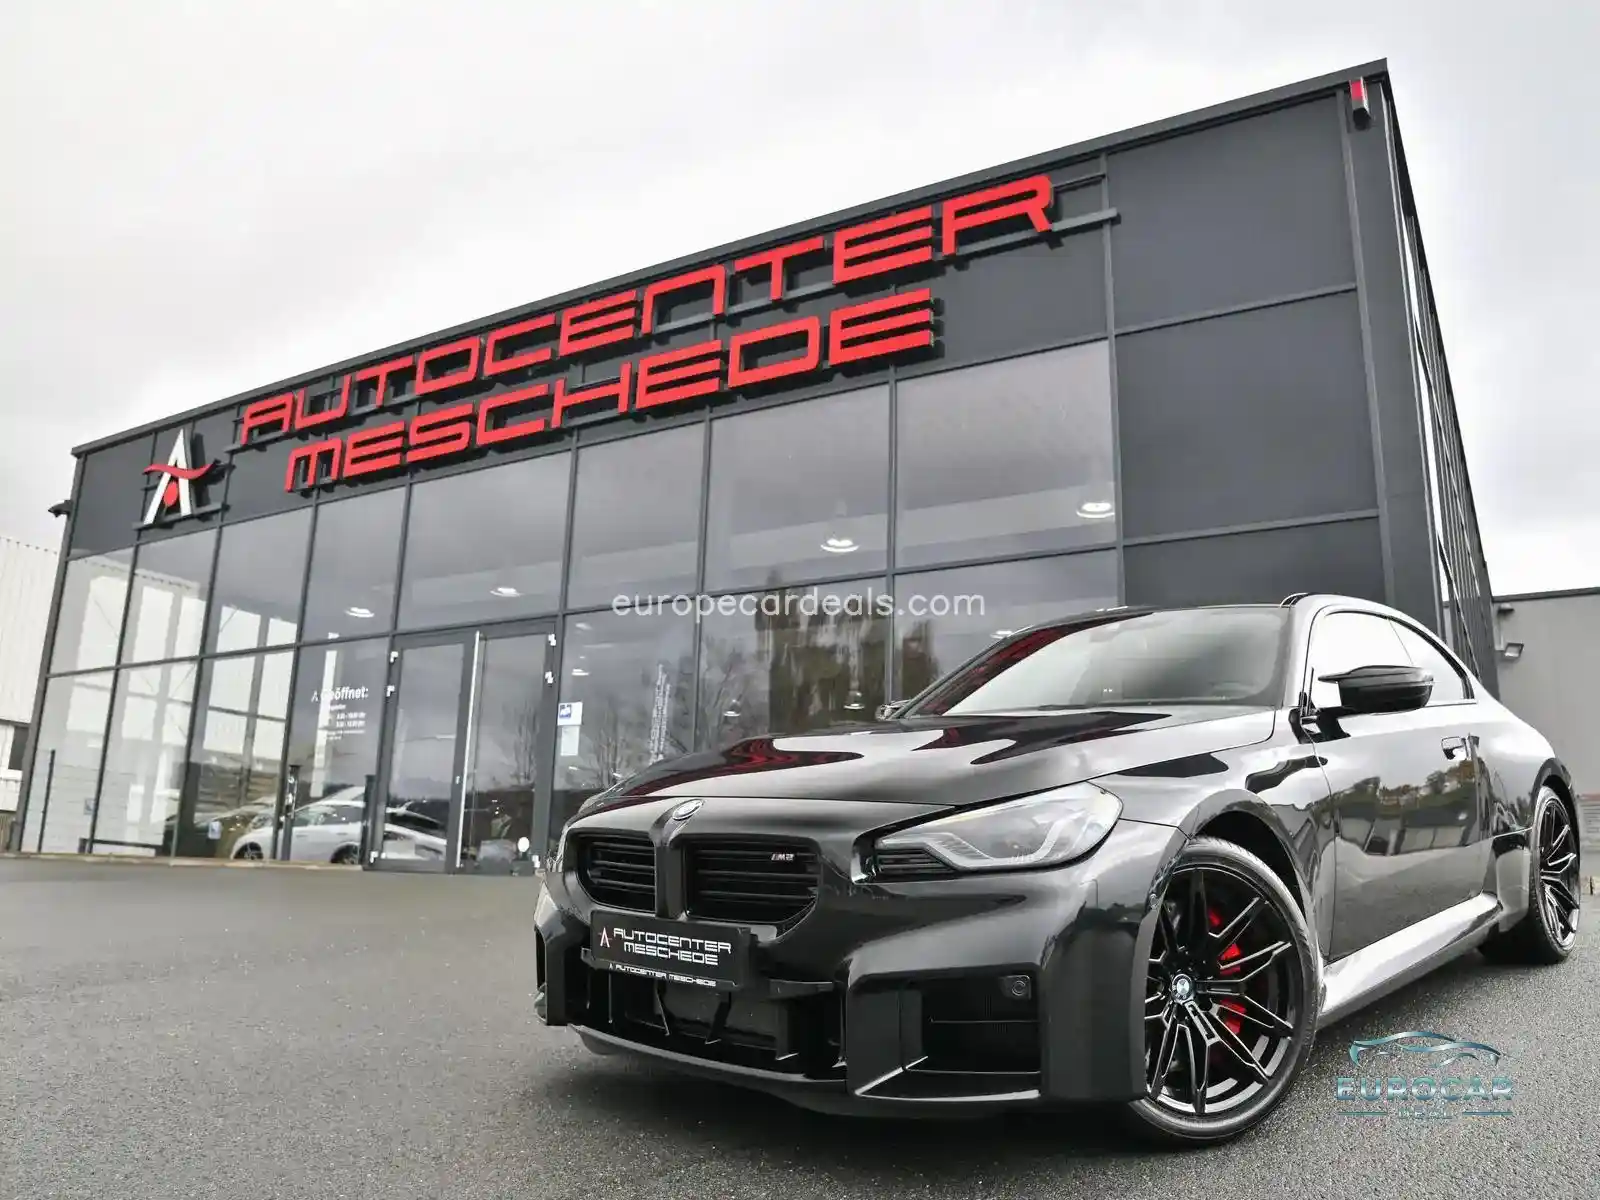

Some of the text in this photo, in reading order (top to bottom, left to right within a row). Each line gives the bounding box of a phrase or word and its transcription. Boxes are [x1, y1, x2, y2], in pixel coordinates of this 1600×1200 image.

[240, 174, 1053, 445] AUTOCENTER
[284, 288, 934, 493] MESCHEDE
[613, 927, 731, 954] AUTOCENTER
[624, 941, 718, 966] MESCHEDE
[615, 964, 667, 980] AUTOCENTER
